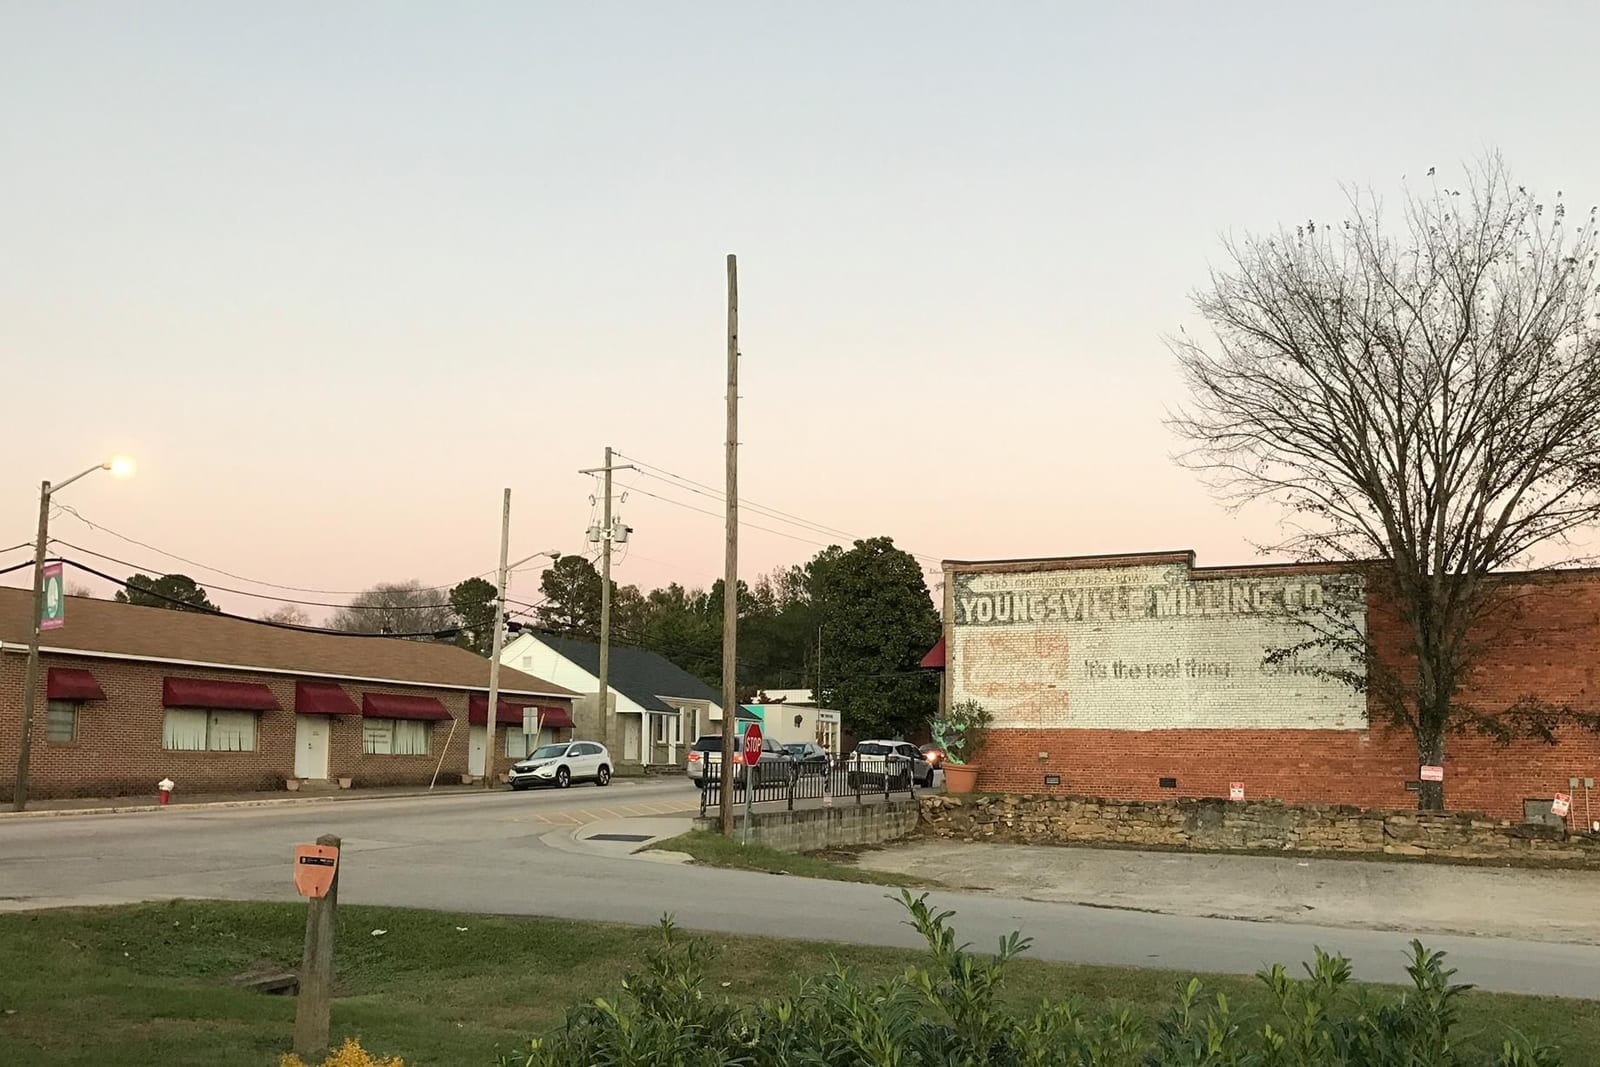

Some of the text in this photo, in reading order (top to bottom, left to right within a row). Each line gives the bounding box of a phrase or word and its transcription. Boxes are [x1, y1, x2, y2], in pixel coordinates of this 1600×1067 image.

[961, 587, 1145, 622] YOUNGSVILLE
[1155, 583, 1272, 617] MILLING
[1111, 659, 1141, 679] the
[1146, 657, 1180, 679] real
[746, 736, 761, 752] STOP
